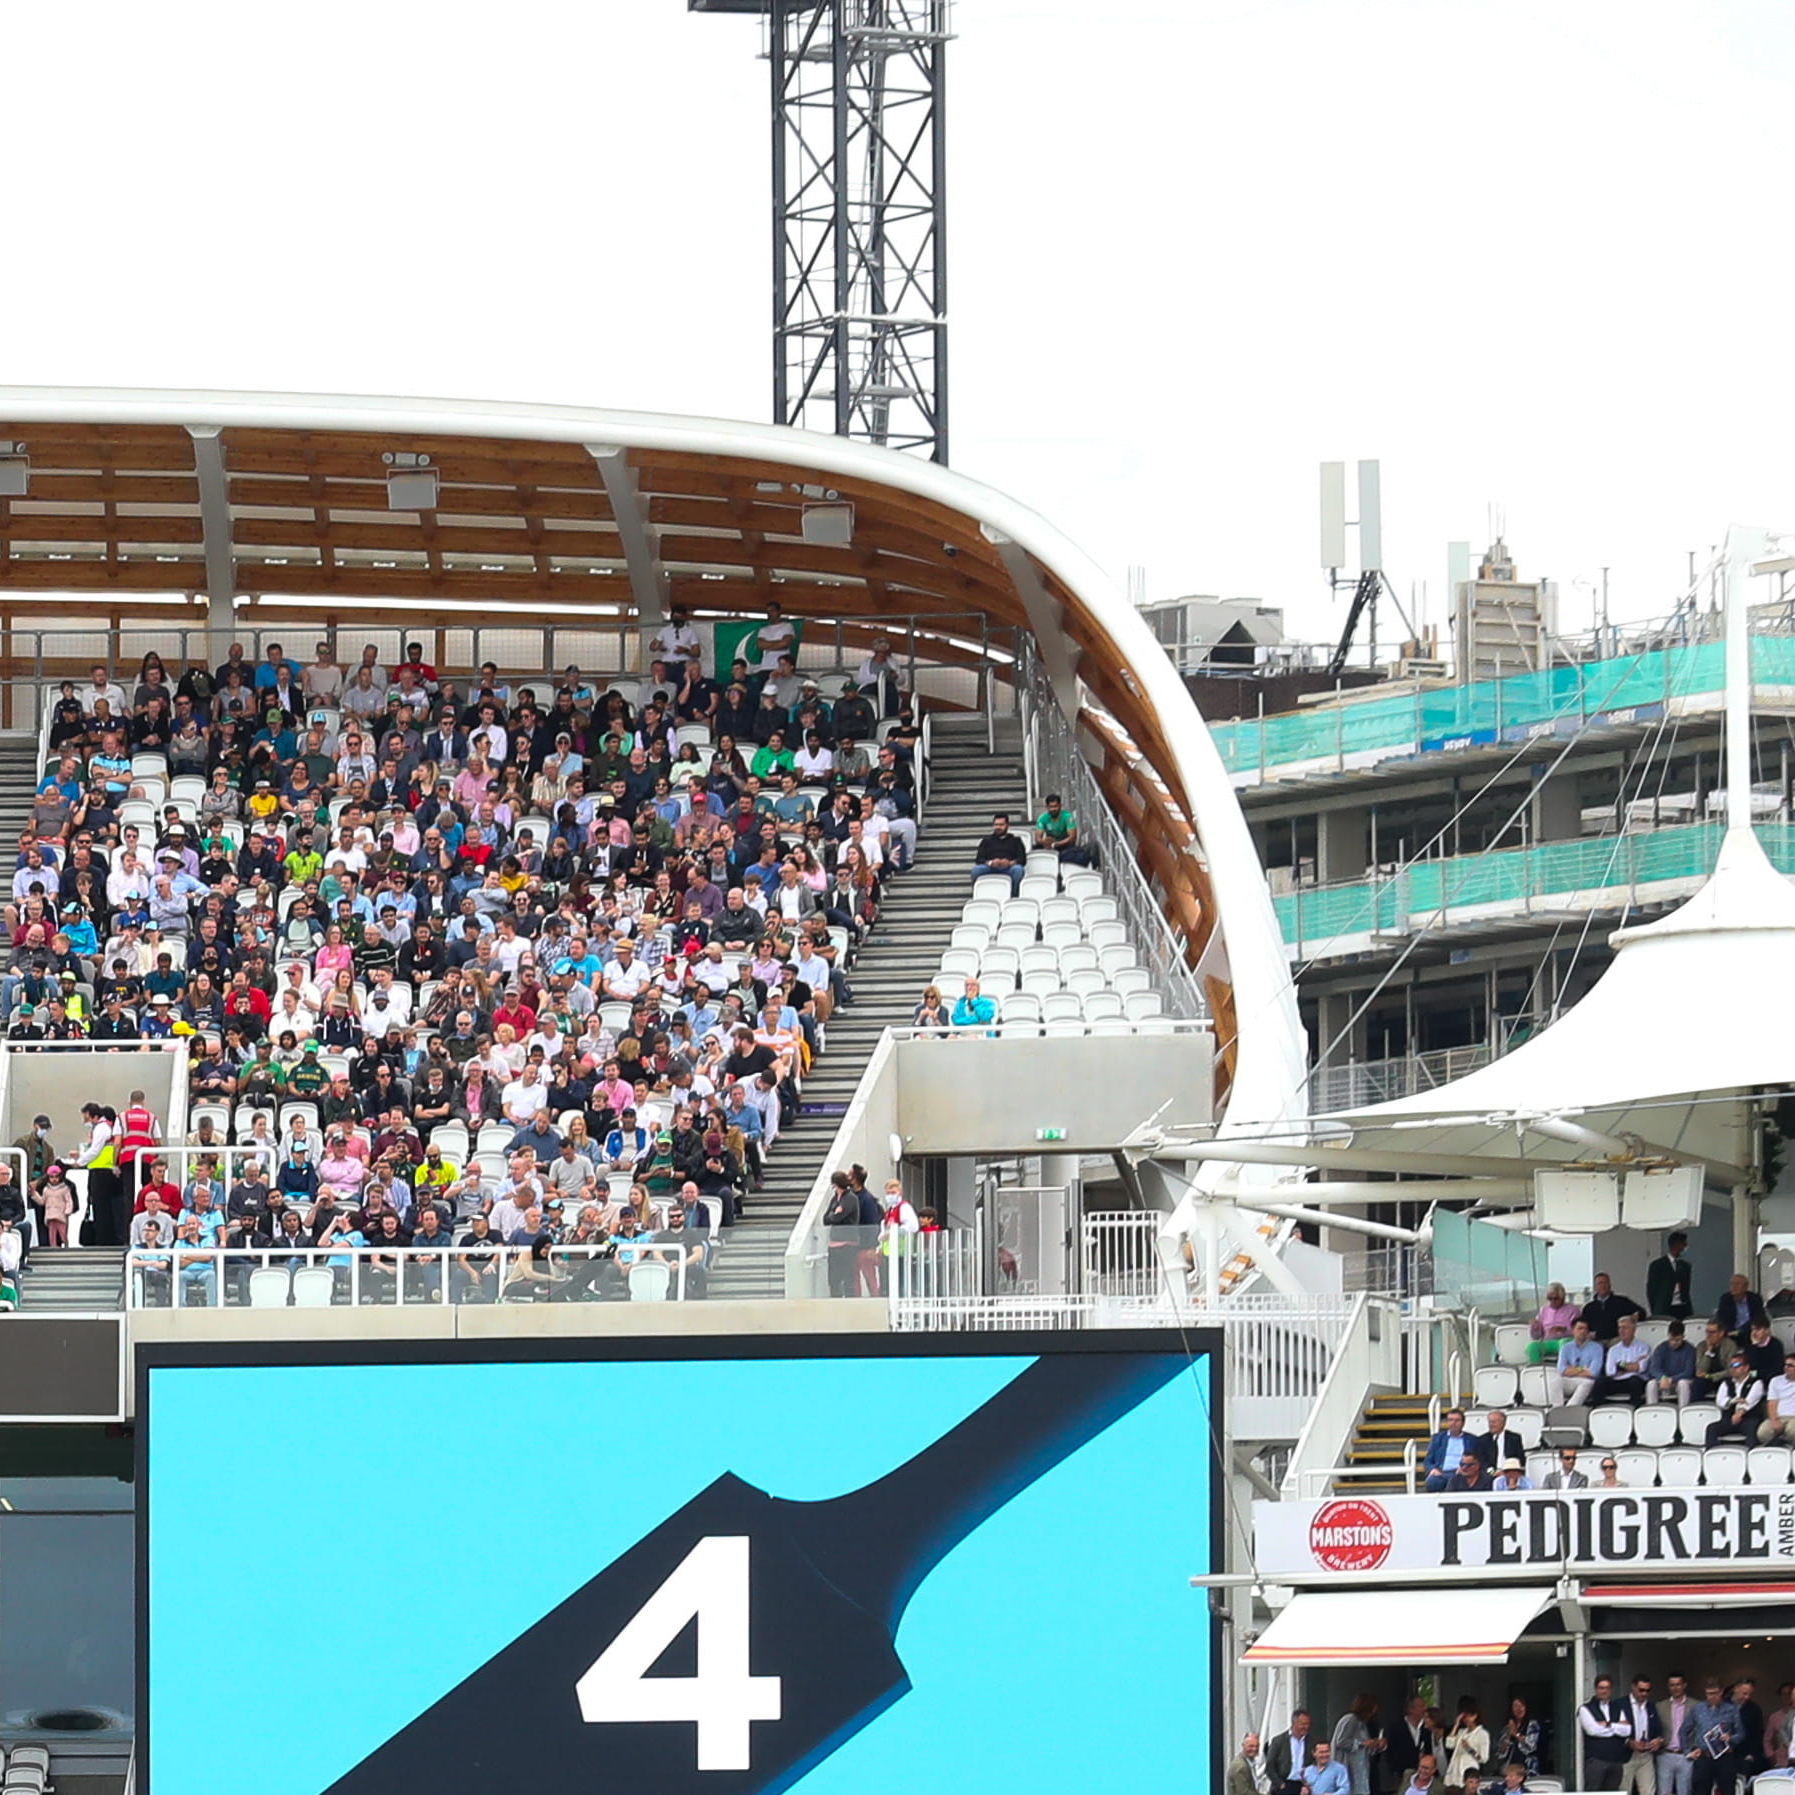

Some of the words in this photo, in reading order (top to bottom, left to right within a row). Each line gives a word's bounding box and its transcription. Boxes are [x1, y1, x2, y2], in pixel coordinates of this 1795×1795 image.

[1312, 1523, 1391, 1548] MARSTON'S
[1439, 1493, 1770, 1565] PEDIGREE
[1777, 1494, 1795, 1556] AMBER
[577, 1536, 780, 1770] 4
